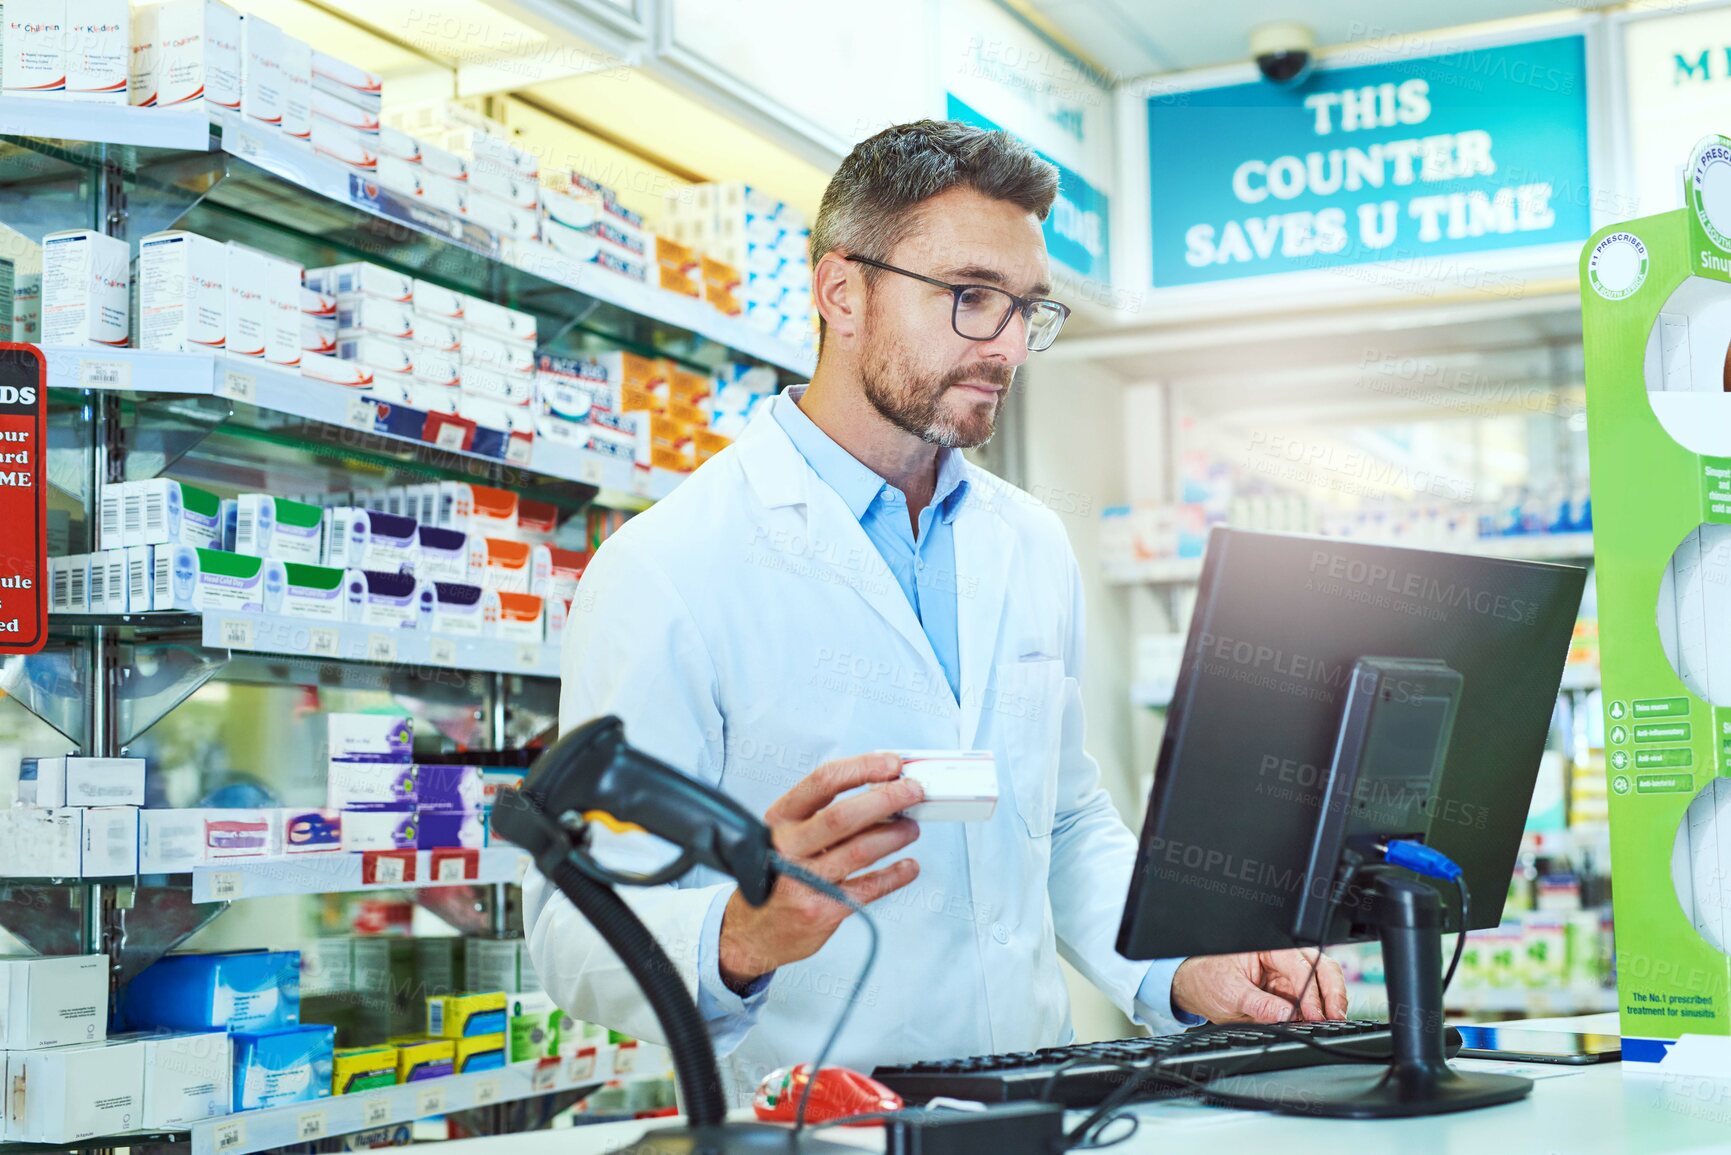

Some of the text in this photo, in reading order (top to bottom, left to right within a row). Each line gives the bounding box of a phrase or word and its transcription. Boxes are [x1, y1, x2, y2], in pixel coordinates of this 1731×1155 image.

[24, 22, 60, 33] Children
[1304, 79, 1431, 136] THIS
[1232, 129, 1497, 204] COUNTER
[1184, 182, 1555, 268] SAVES U TIME
[1596, 233, 1645, 254] PRESCRIBED
[1633, 992, 1647, 1002] The
[1669, 994, 1712, 1005] prescribed
[1627, 1006, 1716, 1019] treatment for sinusitis
